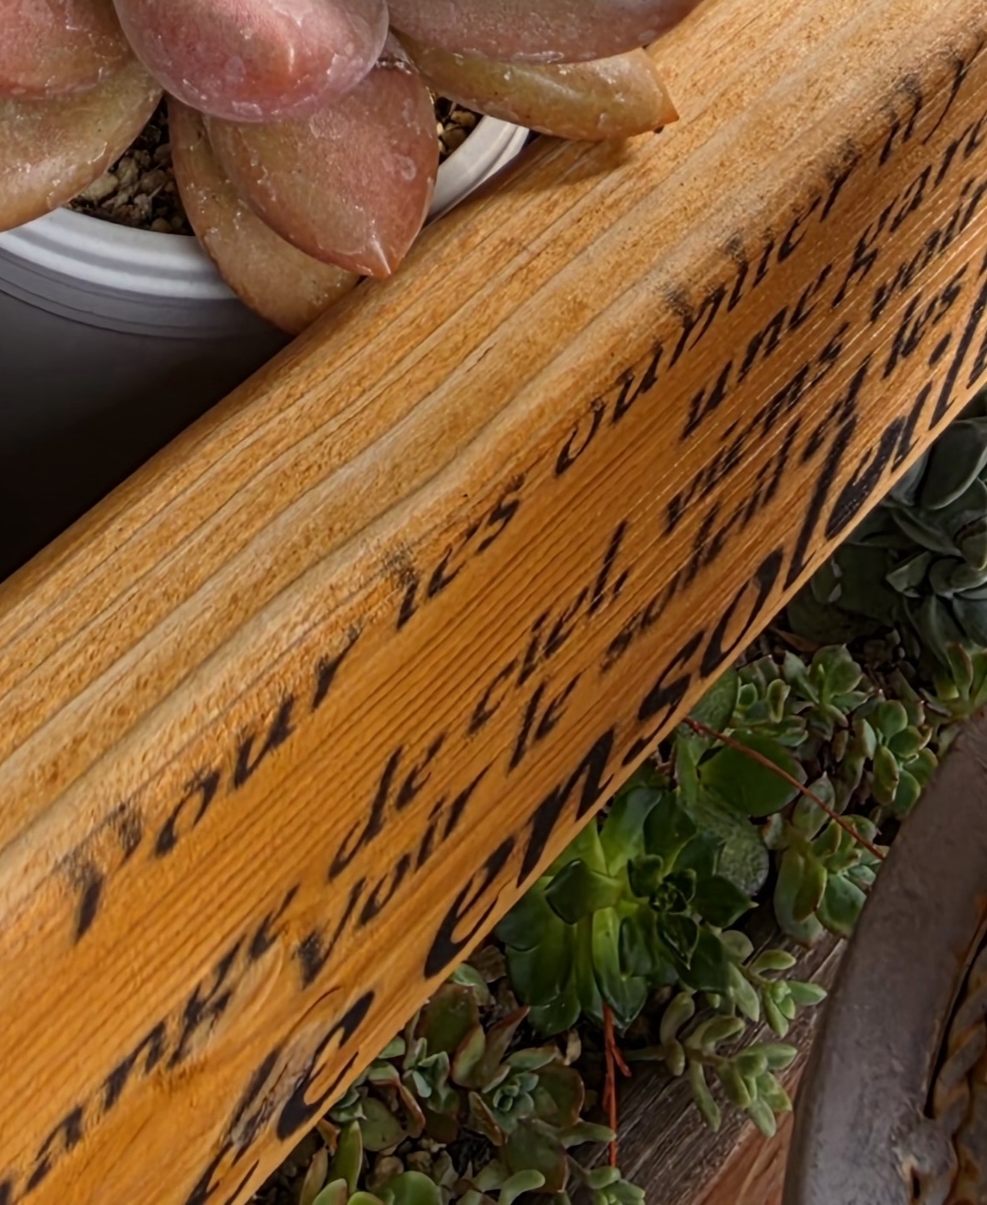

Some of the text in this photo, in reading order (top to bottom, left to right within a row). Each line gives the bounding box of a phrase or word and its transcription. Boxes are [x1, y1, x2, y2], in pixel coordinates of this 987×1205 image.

[298, 267, 966, 987] Voir le soleil et les
[329, 735, 444, 880] de
[468, 520, 630, 734] ciel,
[664, 322, 850, 537] viens
[679, 263, 833, 442] une
